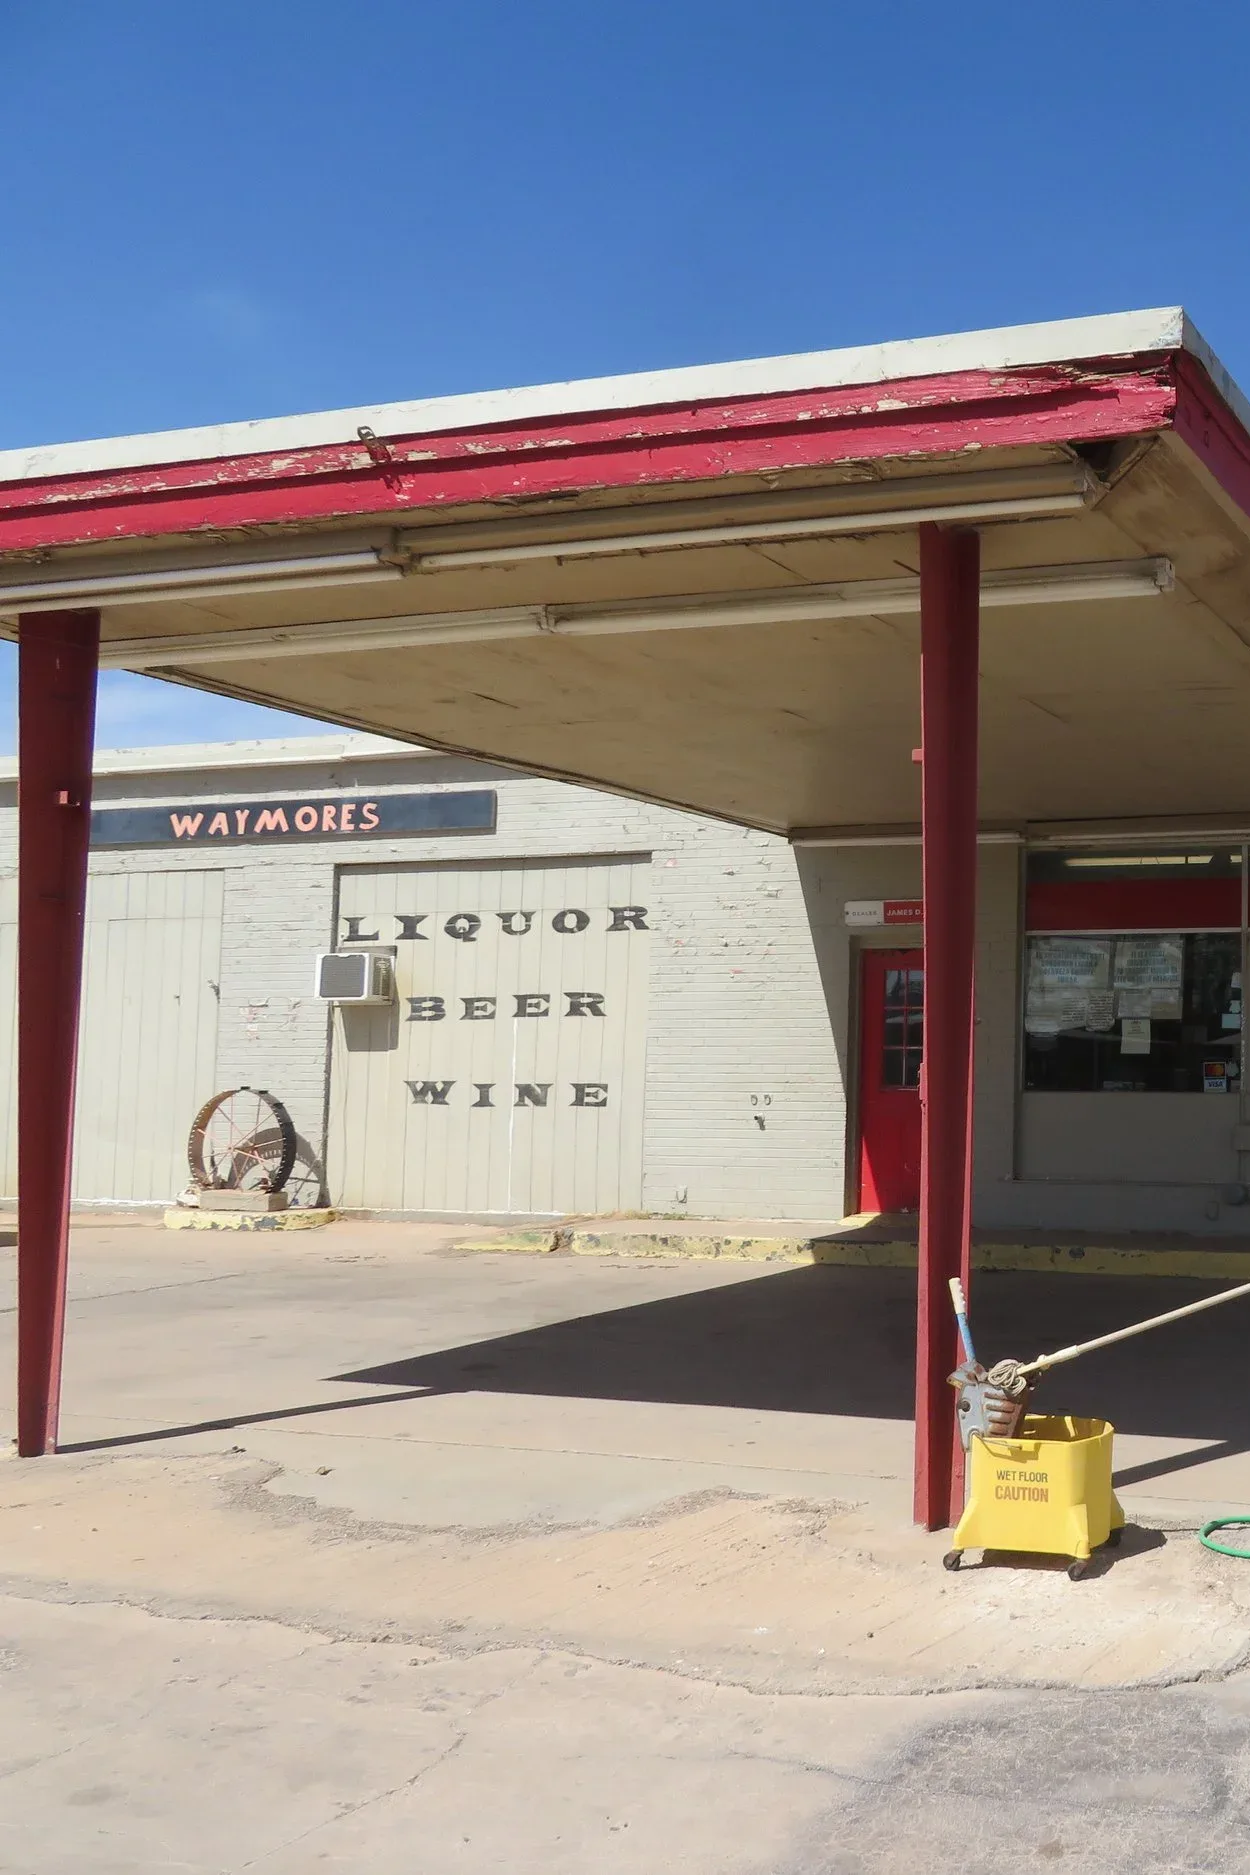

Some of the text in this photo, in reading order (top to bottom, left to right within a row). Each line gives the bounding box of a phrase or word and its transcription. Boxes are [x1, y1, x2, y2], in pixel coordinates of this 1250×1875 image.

[169, 802, 380, 838] WAYMORES
[342, 905, 650, 942] LIQUOR
[886, 908, 913, 916] JAMES
[405, 991, 607, 1022] BEER
[403, 1080, 609, 1107] WINE
[996, 1470, 1048, 1483] WET FLOOR
[995, 1485, 1049, 1503] CAUTION
